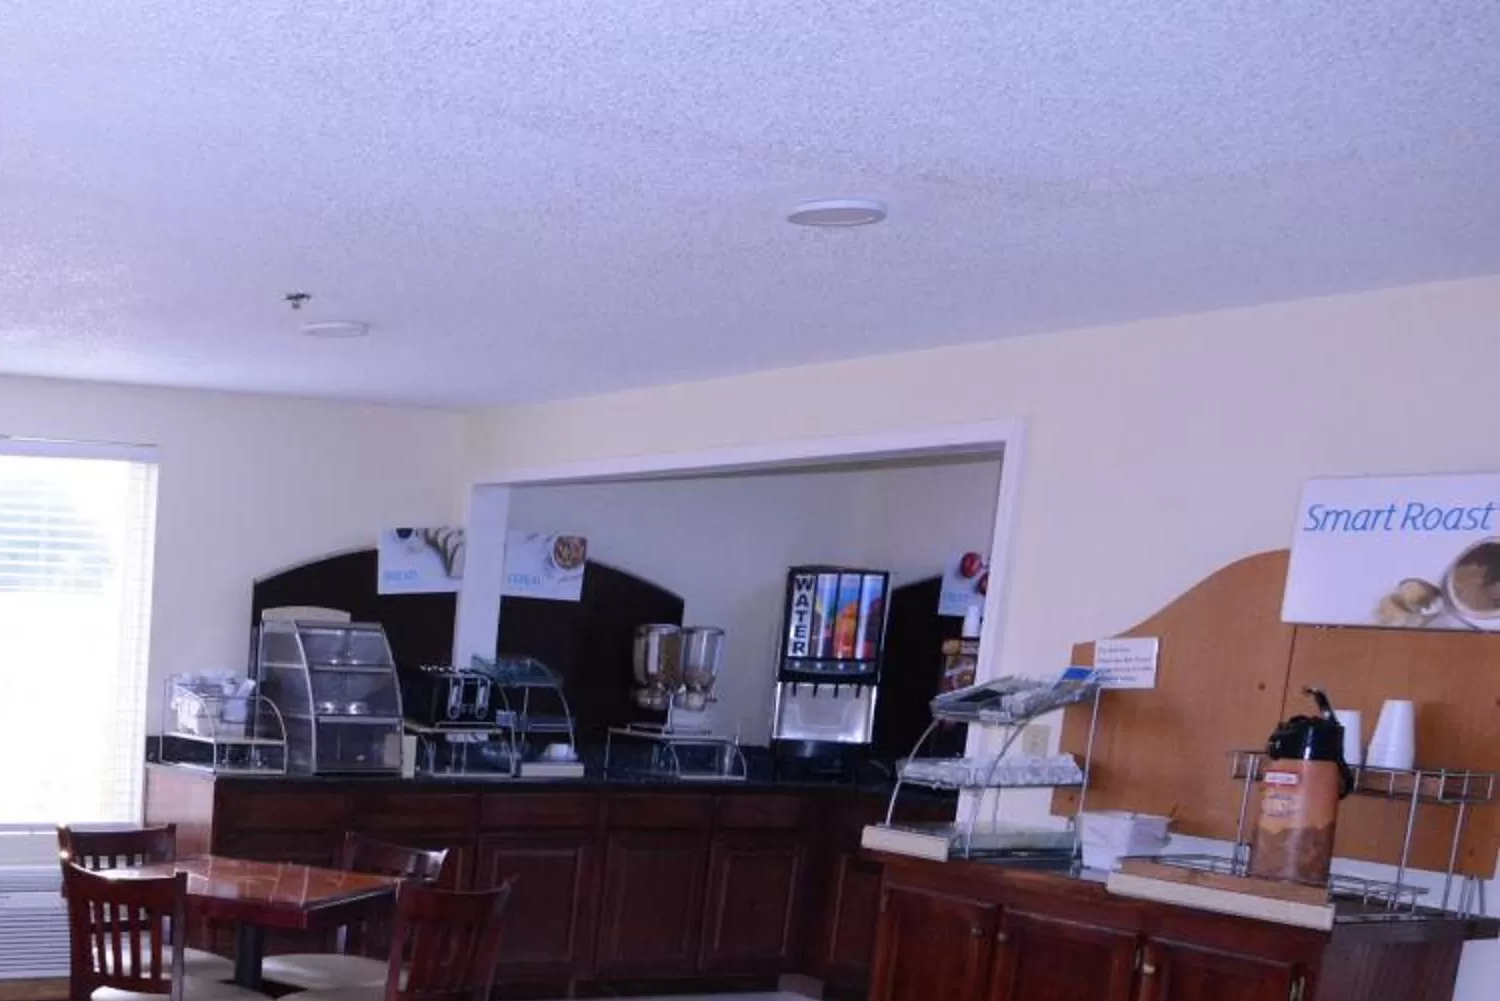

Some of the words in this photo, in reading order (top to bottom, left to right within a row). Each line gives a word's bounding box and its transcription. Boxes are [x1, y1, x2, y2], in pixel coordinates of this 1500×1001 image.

[1303, 504, 1396, 532] Smart
[1401, 502, 1499, 532] Roast
[792, 577, 814, 656] WATER
